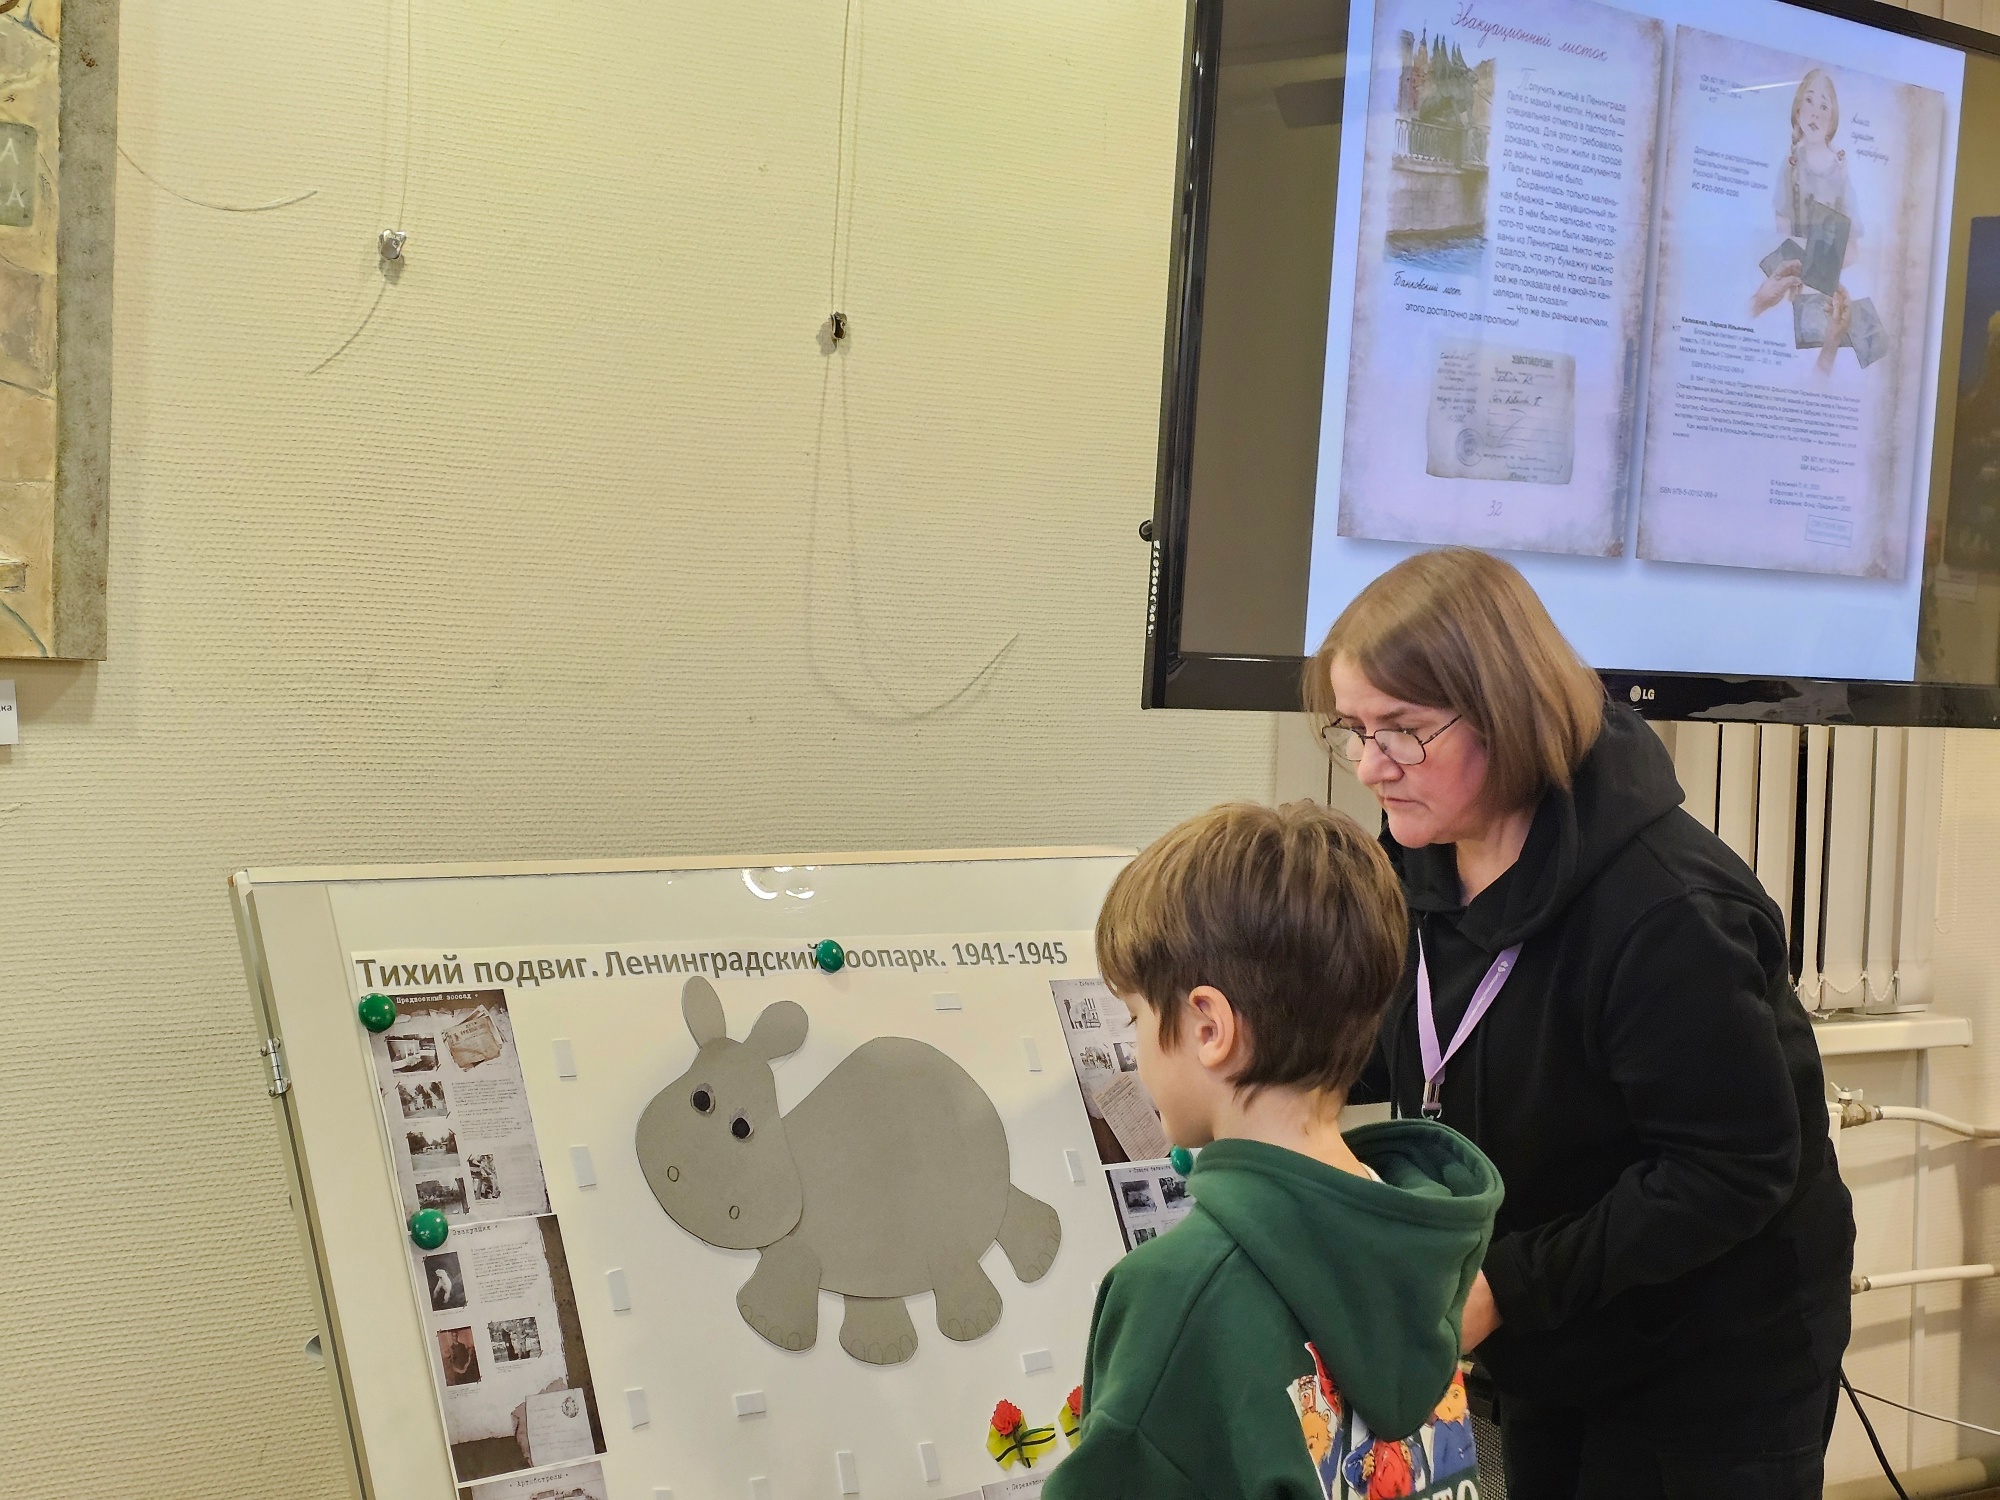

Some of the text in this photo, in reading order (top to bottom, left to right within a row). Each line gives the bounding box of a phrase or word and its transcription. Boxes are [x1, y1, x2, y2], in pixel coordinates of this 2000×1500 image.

[1451, 2, 1608, 61] Эвакуационный листок
[1518, 68, 1556, 95] Получить
[1558, 90, 1580, 102] жильё
[1586, 95, 1627, 112] Ленинграде
[1508, 90, 1523, 101] Галя
[1530, 97, 1552, 109] мамой
[1553, 104, 1562, 112] не
[1563, 105, 1584, 116] могли.
[1586, 109, 1608, 122] Нужна
[1609, 114, 1626, 126] была
[1507, 107, 1551, 122] специальная
[1552, 117, 1579, 129] отметка
[1585, 124, 1616, 138] паспорте
[1505, 135, 1540, 149] доказать,
[1542, 143, 1554, 152] что
[1556, 146, 1569, 155] они
[1571, 148, 1590, 159] жили
[1598, 155, 1622, 166] городе
[1506, 121, 1623, 153] прописка. Для этого требовалось
[1504, 149, 1622, 180] до войны. Но никаких документов
[1509, 162, 1524, 173] Гали
[1532, 168, 1554, 180] мамой
[1555, 174, 1563, 182] не
[1565, 174, 1584, 186] было.
[1500, 191, 1513, 200] кая
[1514, 192, 1545, 206] бумажка
[1555, 201, 1606, 218] эвакуационный
[1607, 211, 1618, 219] ли-
[1516, 178, 1619, 206] Сохранилась только малень-
[1498, 219, 1616, 247] кого-то числа они были эвакуиро-
[1500, 205, 1516, 214] сток.
[1526, 209, 1539, 219] нём
[1540, 211, 1559, 223] было
[1560, 217, 1593, 230] написано,
[1595, 223, 1606, 232] что
[1608, 225, 1617, 233] та-
[1496, 246, 1614, 274] гадался, что эту бумажку можно
[1497, 232, 1615, 261] ваны из Ленинграда. Никто не до-
[1394, 271, 1438, 292] Банковский
[1494, 273, 1506, 283] всё
[1508, 277, 1518, 285] же
[1519, 278, 1551, 292] показала
[1553, 284, 1561, 293] её
[1568, 286, 1596, 298] какой-то
[1598, 291, 1612, 301] кан-
[1495, 261, 1613, 287] считать документом. Но когда Галя
[1406, 304, 1520, 327] этого достаточно для прописки!
[1516, 305, 1529, 315] Что
[1530, 309, 1540, 317] же
[1541, 311, 1551, 319] вы
[1552, 312, 1579, 324] раньше
[1580, 316, 1609, 328] молчали,
[1487, 500, 1503, 517] 32
[1642, 689, 1655, 700] LG
[356, 954, 464, 988] Тихий
[473, 957, 599, 988] подвиг.
[844, 949, 947, 973] оопарк.
[952, 942, 1068, 967] 1941-1945
[396, 994, 443, 1005] Предвоенный
[453, 1226, 491, 1235] Эвакуация
[517, 1474, 562, 1487] Артобстрелы
